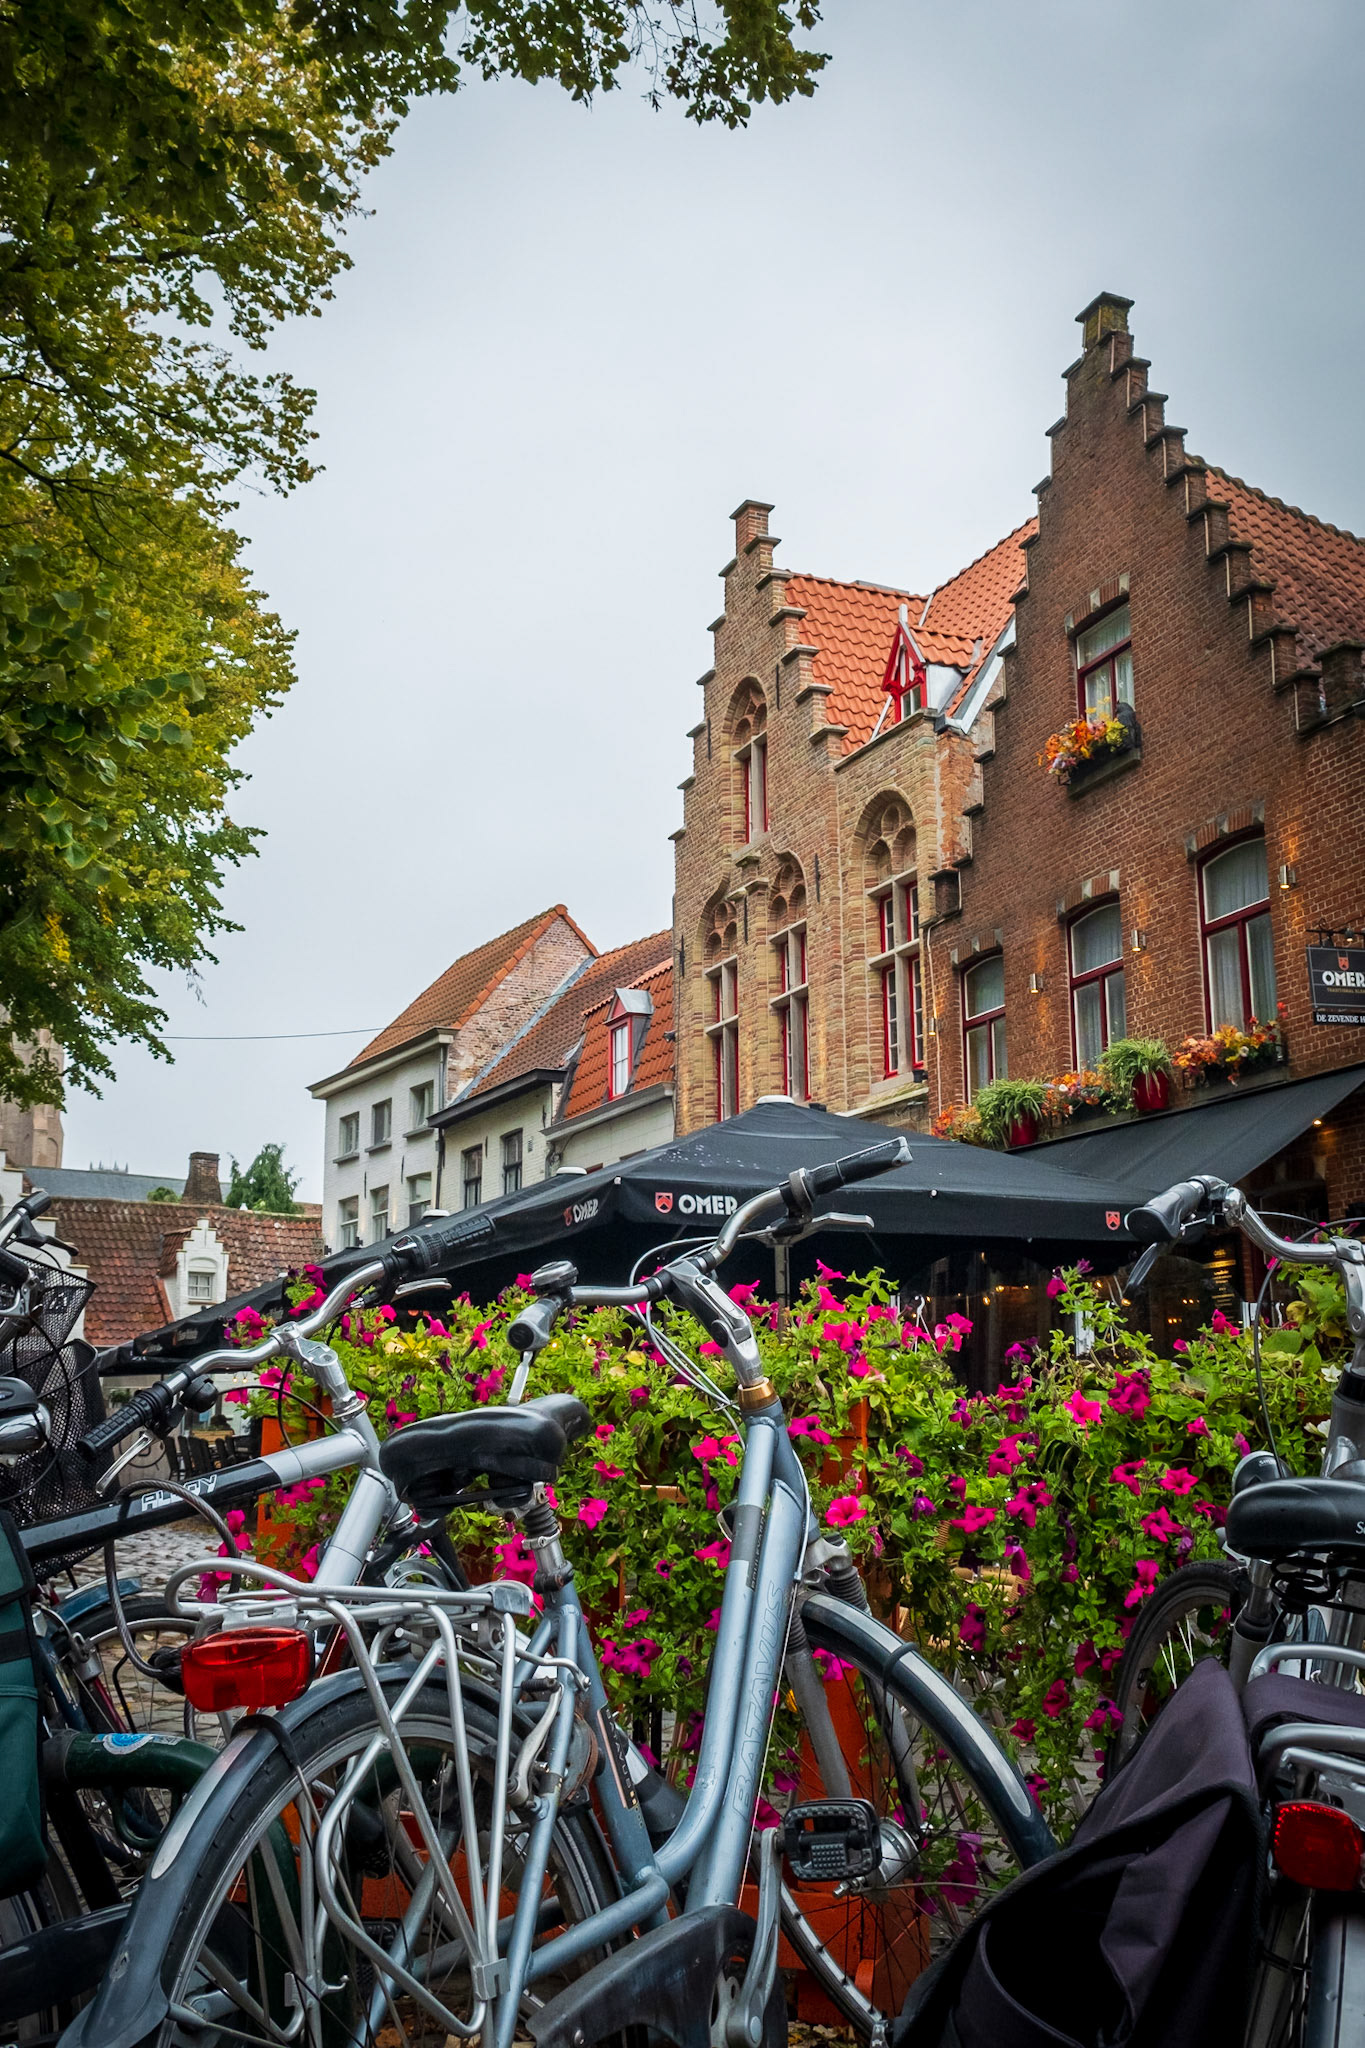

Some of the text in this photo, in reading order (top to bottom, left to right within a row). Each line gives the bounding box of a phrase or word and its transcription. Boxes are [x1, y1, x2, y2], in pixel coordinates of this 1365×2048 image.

[1322, 970, 1365, 988] OMER
[1316, 1014, 1327, 1023] DE
[1328, 1014, 1360, 1024] ZEVENDE
[573, 1198, 599, 1224] OMER
[678, 1194, 738, 1216] OMER
[1355, 1520, 1365, 1535] S
[732, 1579, 785, 1820] BATAVUS
[605, 1708, 632, 1789] BATAVUS
